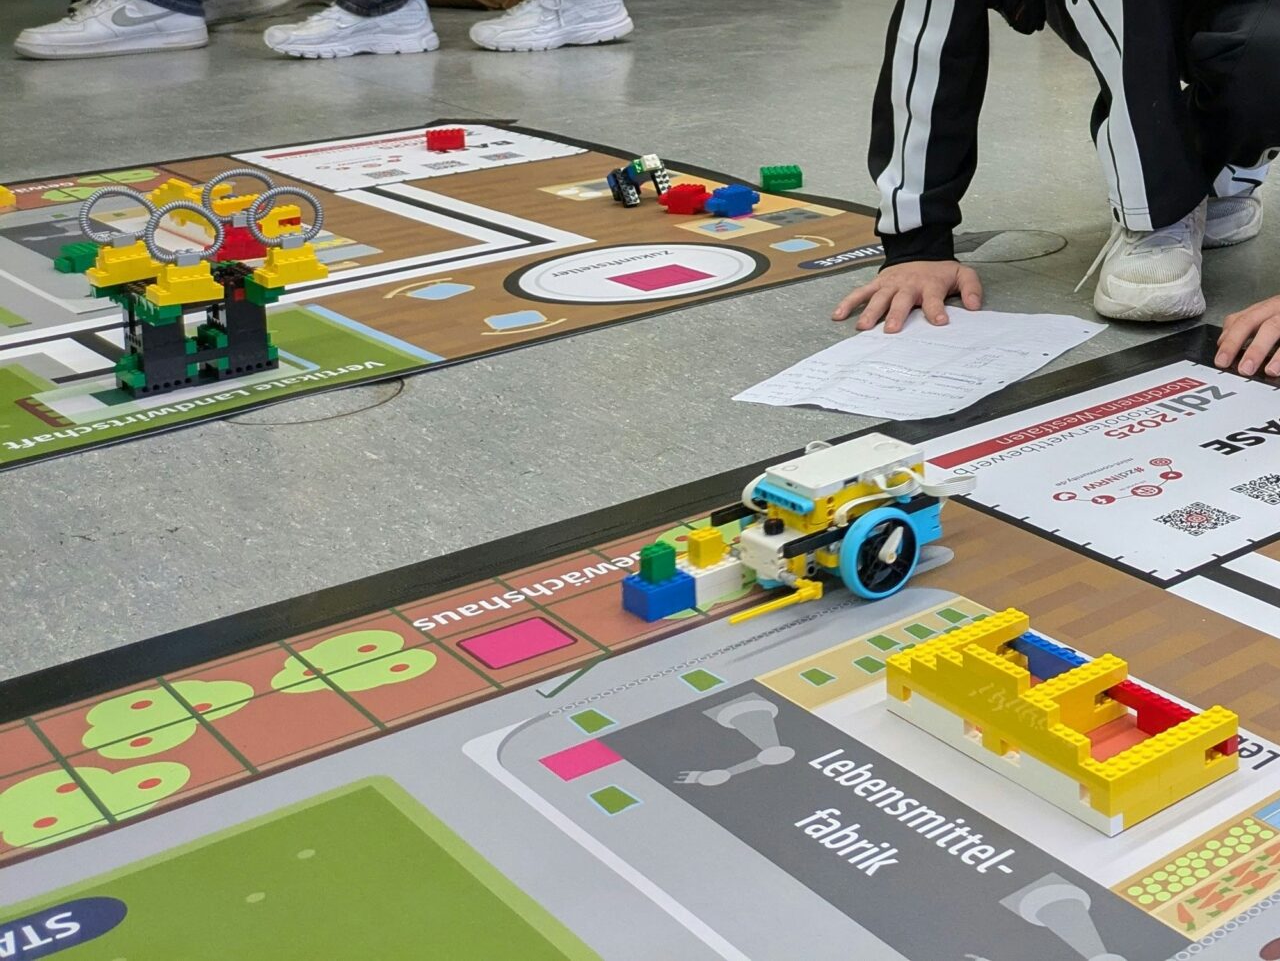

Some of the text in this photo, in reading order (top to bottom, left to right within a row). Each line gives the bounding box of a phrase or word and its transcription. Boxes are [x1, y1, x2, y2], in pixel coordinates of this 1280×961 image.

[814, 246, 880, 267] HAUSE
[1, 359, 386, 451] Vertikale Landwirtschaft
[995, 379, 1200, 445] Nordrhein-Westfalen
[1104, 385, 1238, 440] zdi 2025
[953, 407, 1161, 476] Roboterwettbewerb
[795, 808, 899, 877] fabrik
[809, 747, 1014, 877] Lebensmittel-
